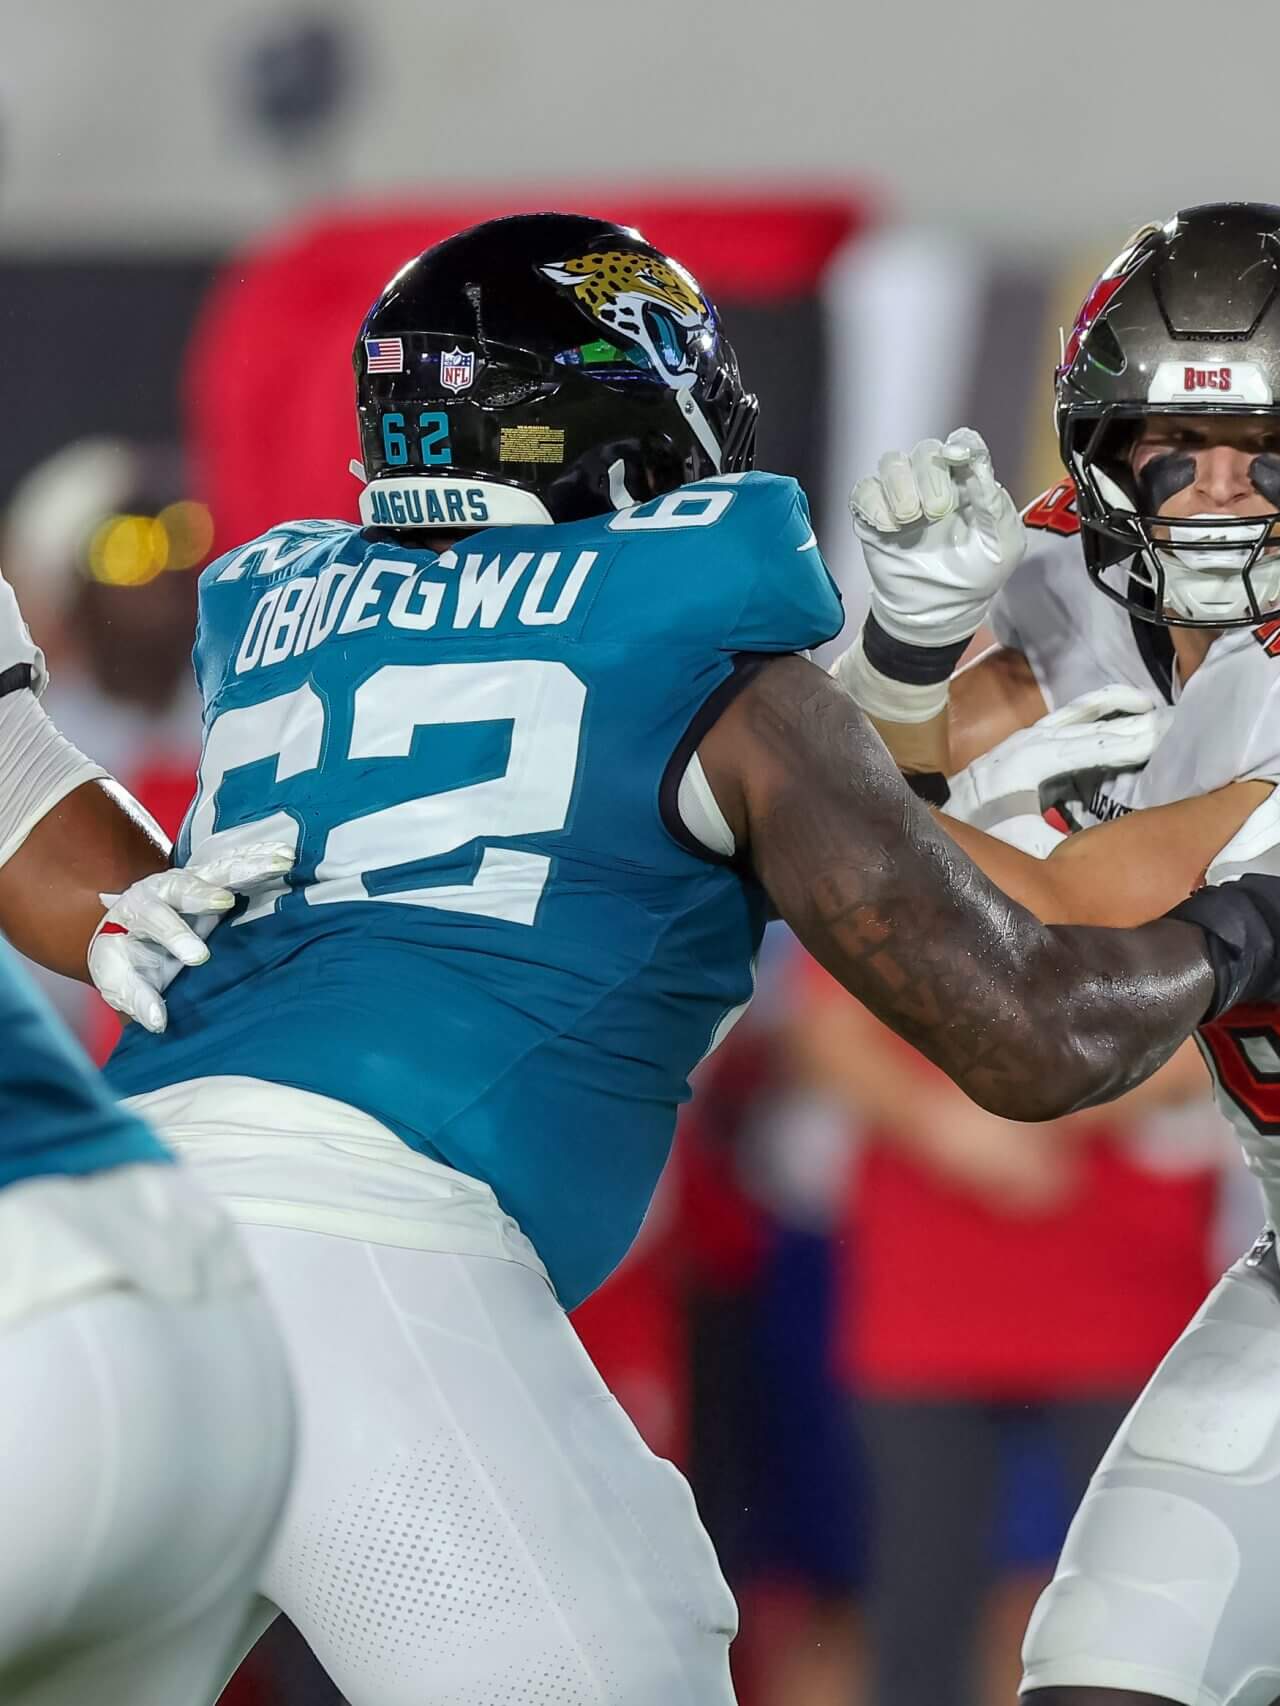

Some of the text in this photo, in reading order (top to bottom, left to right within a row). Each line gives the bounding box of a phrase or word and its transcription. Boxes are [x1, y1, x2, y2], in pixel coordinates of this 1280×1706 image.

[444, 366, 469, 384] NFL
[382, 411, 452, 465] 62
[370, 489, 489, 525] JAGUARS
[186, 659, 588, 928] 62
